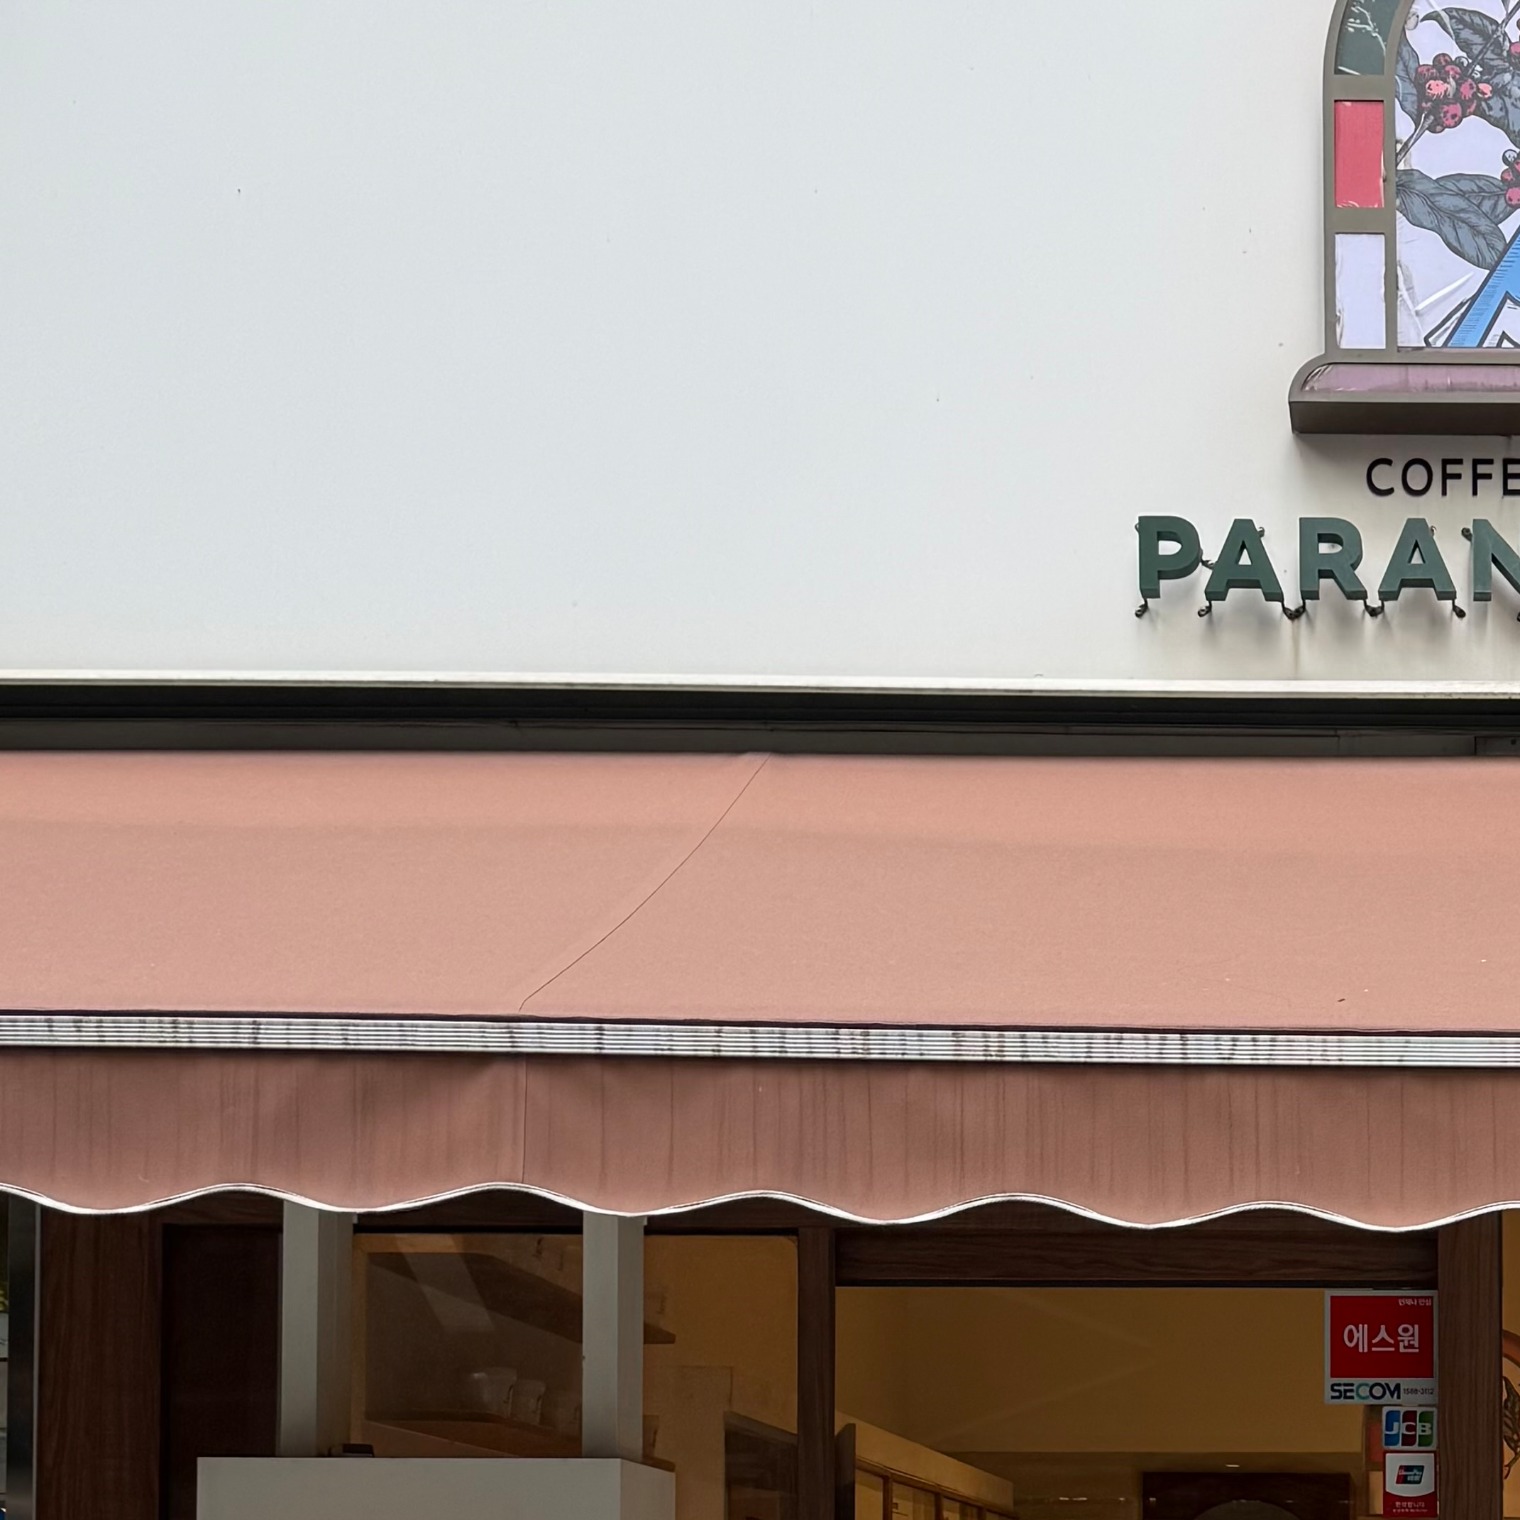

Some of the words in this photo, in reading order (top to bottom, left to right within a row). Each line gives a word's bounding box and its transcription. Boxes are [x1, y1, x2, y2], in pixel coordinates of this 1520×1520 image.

[1343, 1323, 1420, 1353] 에스원
[1330, 1382, 1401, 1400] SECOM
[1384, 1421, 1433, 1436] JCB
